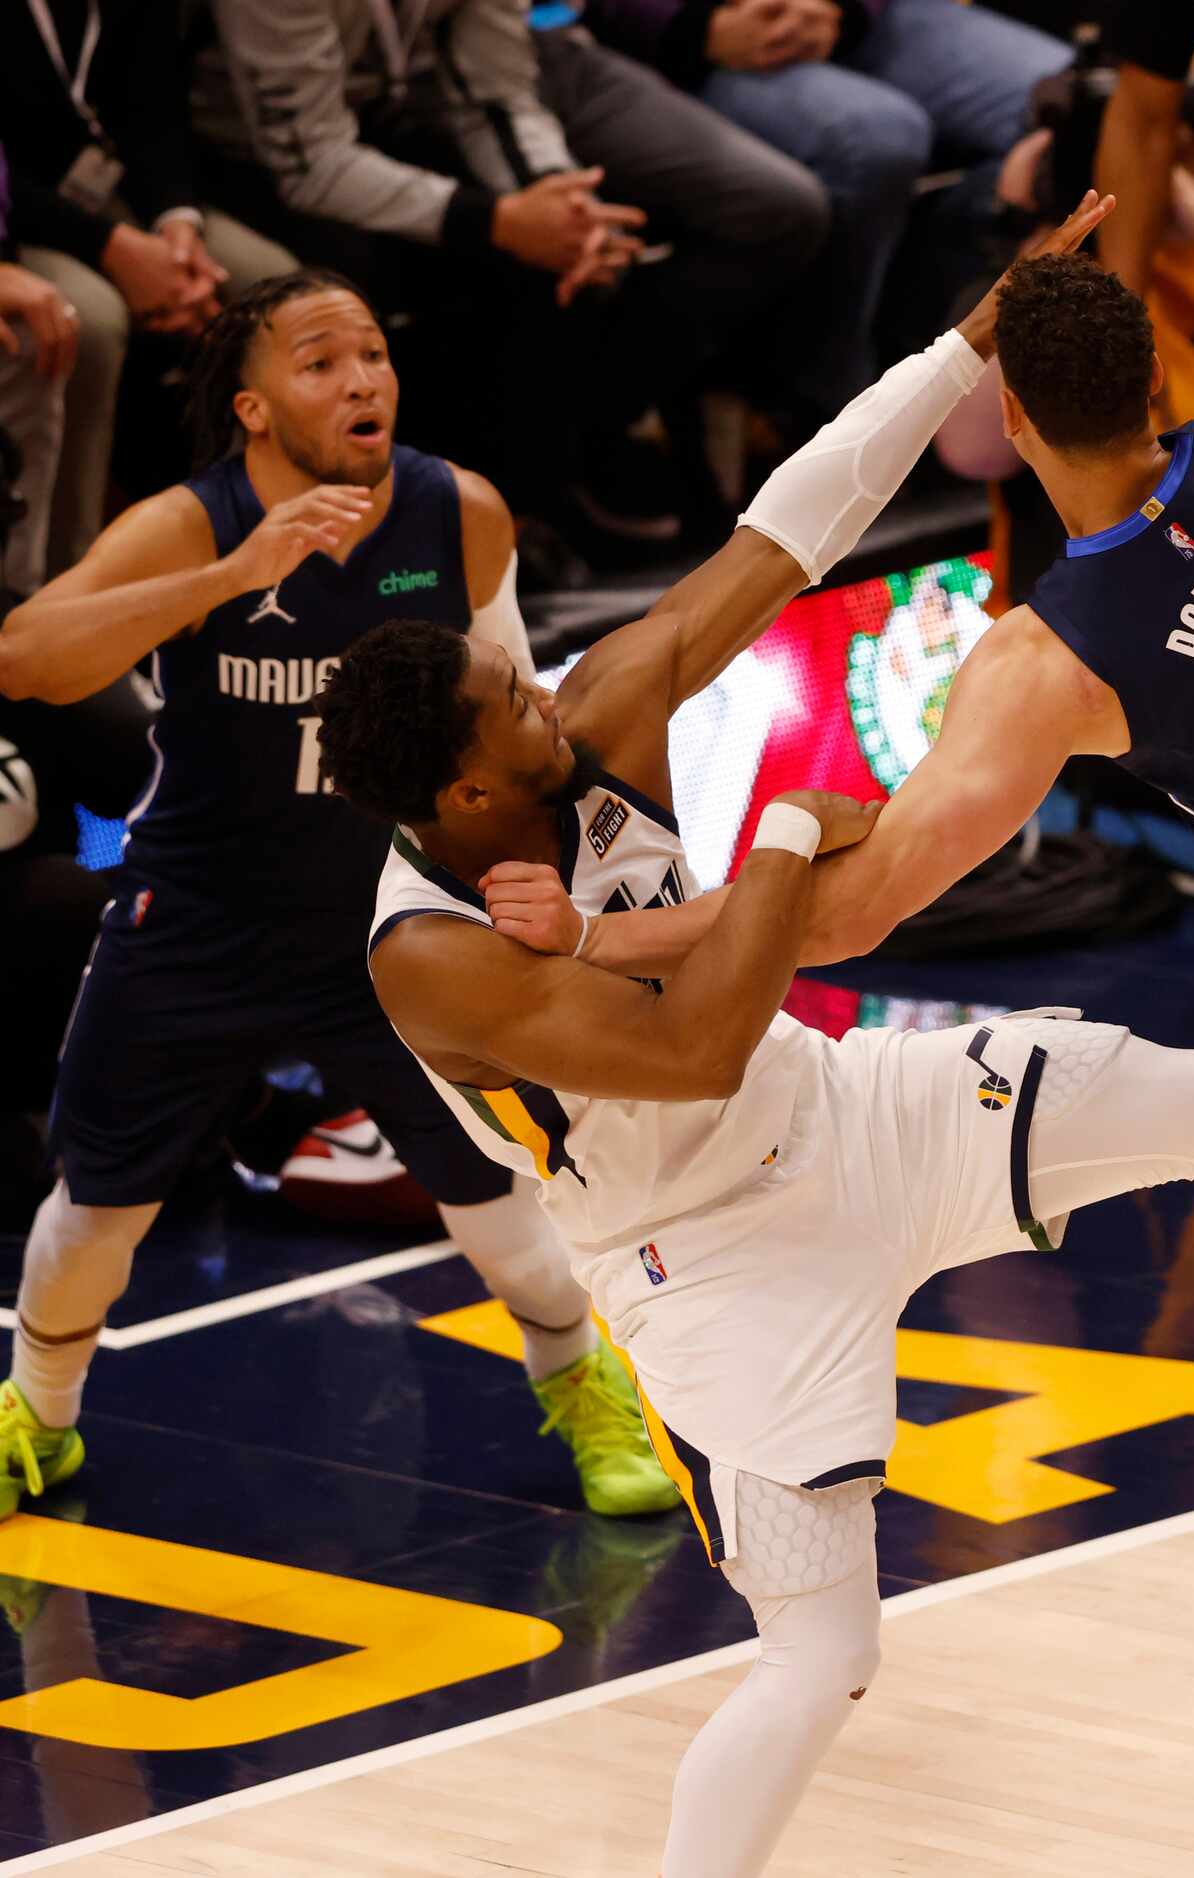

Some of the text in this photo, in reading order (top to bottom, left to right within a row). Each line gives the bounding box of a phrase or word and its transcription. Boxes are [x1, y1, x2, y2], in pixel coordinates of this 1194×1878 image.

[378, 568, 439, 595] chime
[296, 716, 335, 795] 1
[603, 806, 626, 841] FIGHT
[588, 828, 605, 854] 5
